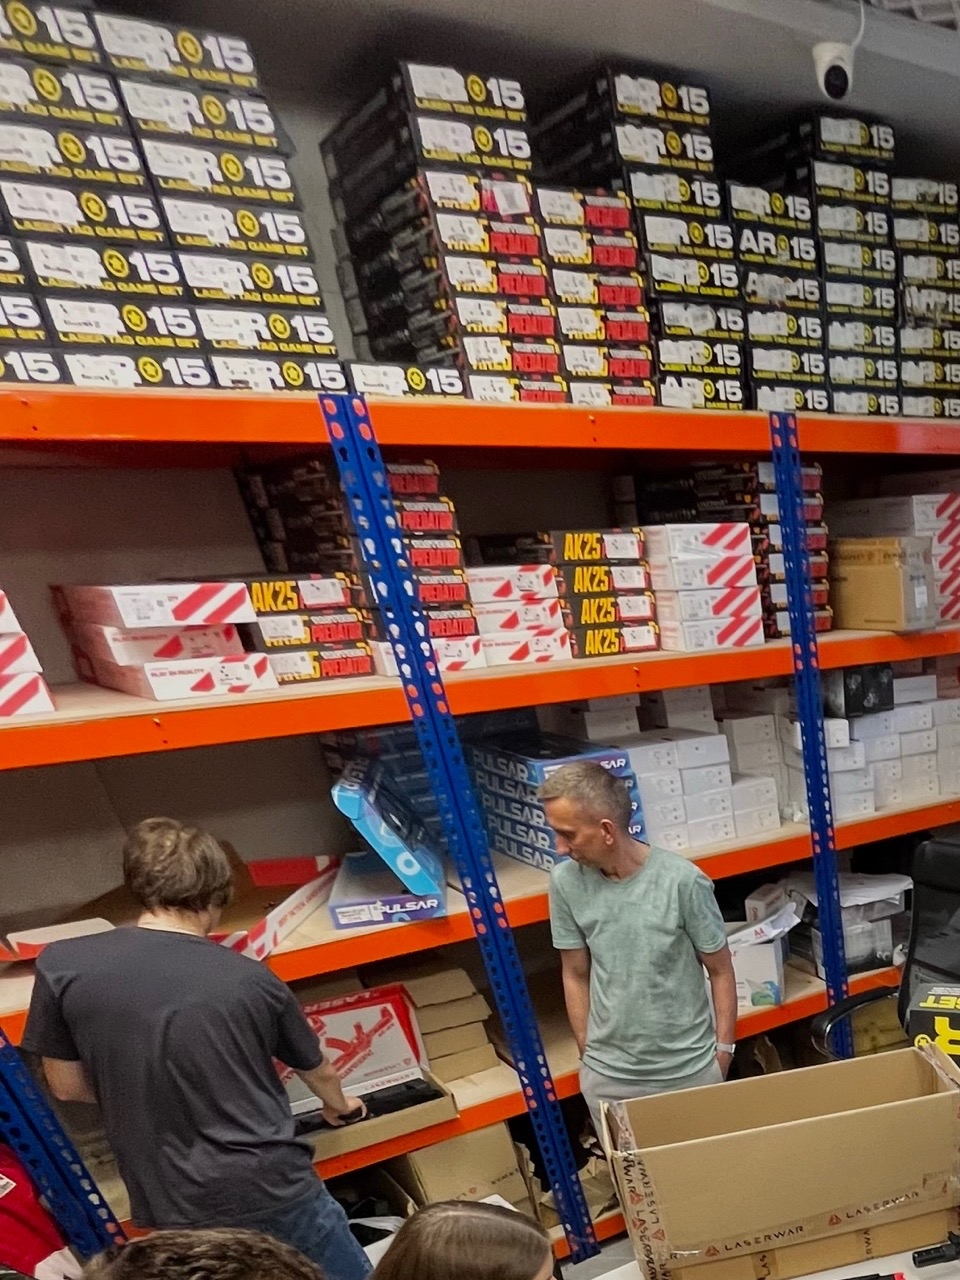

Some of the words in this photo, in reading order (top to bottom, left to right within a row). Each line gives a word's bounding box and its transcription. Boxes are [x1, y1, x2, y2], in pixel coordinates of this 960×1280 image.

[36, 6, 96, 48] 15
[202, 35, 254, 73] 15
[61, 72, 118, 112] 15
[486, 77, 525, 109] 15
[678, 85, 709, 115] 15
[226, 99, 275, 134] 15
[493, 128, 531, 158] 15
[682, 133, 714, 161] 15
[870, 125, 895, 150] 15
[86, 135, 140, 172] 15
[244, 155, 291, 189] 15
[865, 170, 890, 195] 15
[691, 181, 720, 207] 15
[939, 182, 958, 205] 15
[106, 194, 160, 229] 15
[785, 195, 811, 221] 15
[259, 212, 305, 243] 15
[704, 224, 733, 249] 15
[865, 211, 888, 235] 15
[939, 223, 960, 245] 15
[0, 240, 21, 271] 5
[740, 229, 776, 255] AR
[790, 236, 816, 261] 15
[128, 251, 180, 283] 15
[873, 249, 896, 271] 15
[274, 264, 319, 294] 15
[710, 263, 739, 287] 15
[873, 287, 895, 309] 15
[147, 306, 197, 337] 15
[291, 315, 334, 344] 15
[717, 308, 744, 331] 15
[798, 317, 822, 338] 15
[873, 326, 895, 347] 15
[3, 351, 60, 381] 15
[713, 343, 740, 366] 15
[801, 353, 825, 374] 15
[162, 357, 211, 386] 15
[304, 362, 346, 389] 15
[426, 368, 463, 394] 15
[876, 360, 898, 380] 15
[716, 379, 743, 401] 15
[804, 389, 828, 410] 15
[878, 395, 899, 414] 15
[564, 533, 601, 560] AK25
[574, 567, 611, 593] AK25
[251, 581, 298, 612] AK25
[581, 598, 615, 625] AK25
[429, 619, 475, 636] PREDATOR
[585, 630, 619, 654] AK25
[320, 656, 372, 676] PREDATOR
[472, 749, 529, 781] PULSAR
[600, 758, 626, 769] SAR
[482, 791, 546, 827] PULSAR
[488, 814, 551, 849] PULSAR
[495, 835, 555, 872] PULSAR
[380, 899, 438, 914] PULSAR
[845, 1191, 919, 1219] LASERWAR
[724, 1225, 804, 1251] LASERWAR
